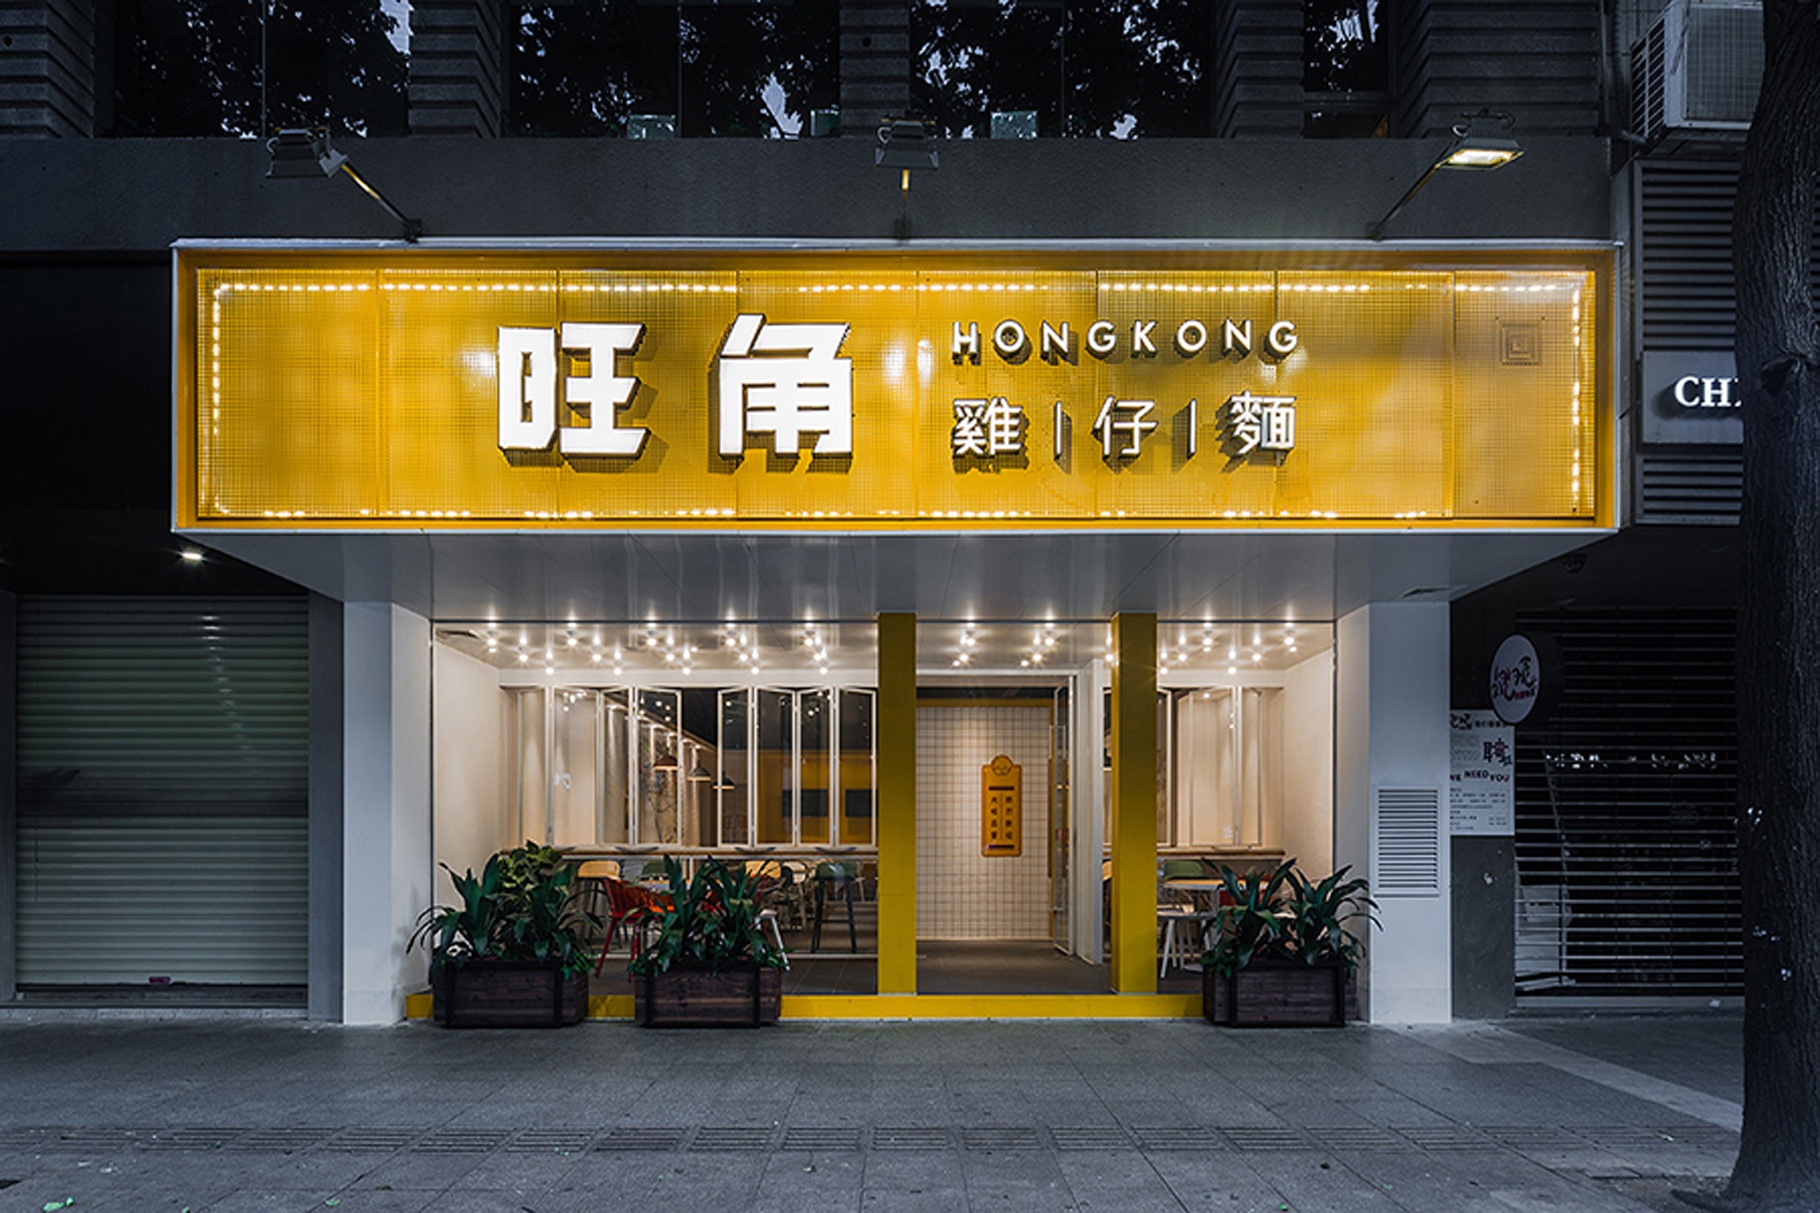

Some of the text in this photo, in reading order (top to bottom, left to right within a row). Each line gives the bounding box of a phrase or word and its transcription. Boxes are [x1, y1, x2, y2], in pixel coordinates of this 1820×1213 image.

[498, 313, 853, 457] 旺角
[1674, 375, 1742, 408] CH
[1464, 769, 1490, 779] NEED
